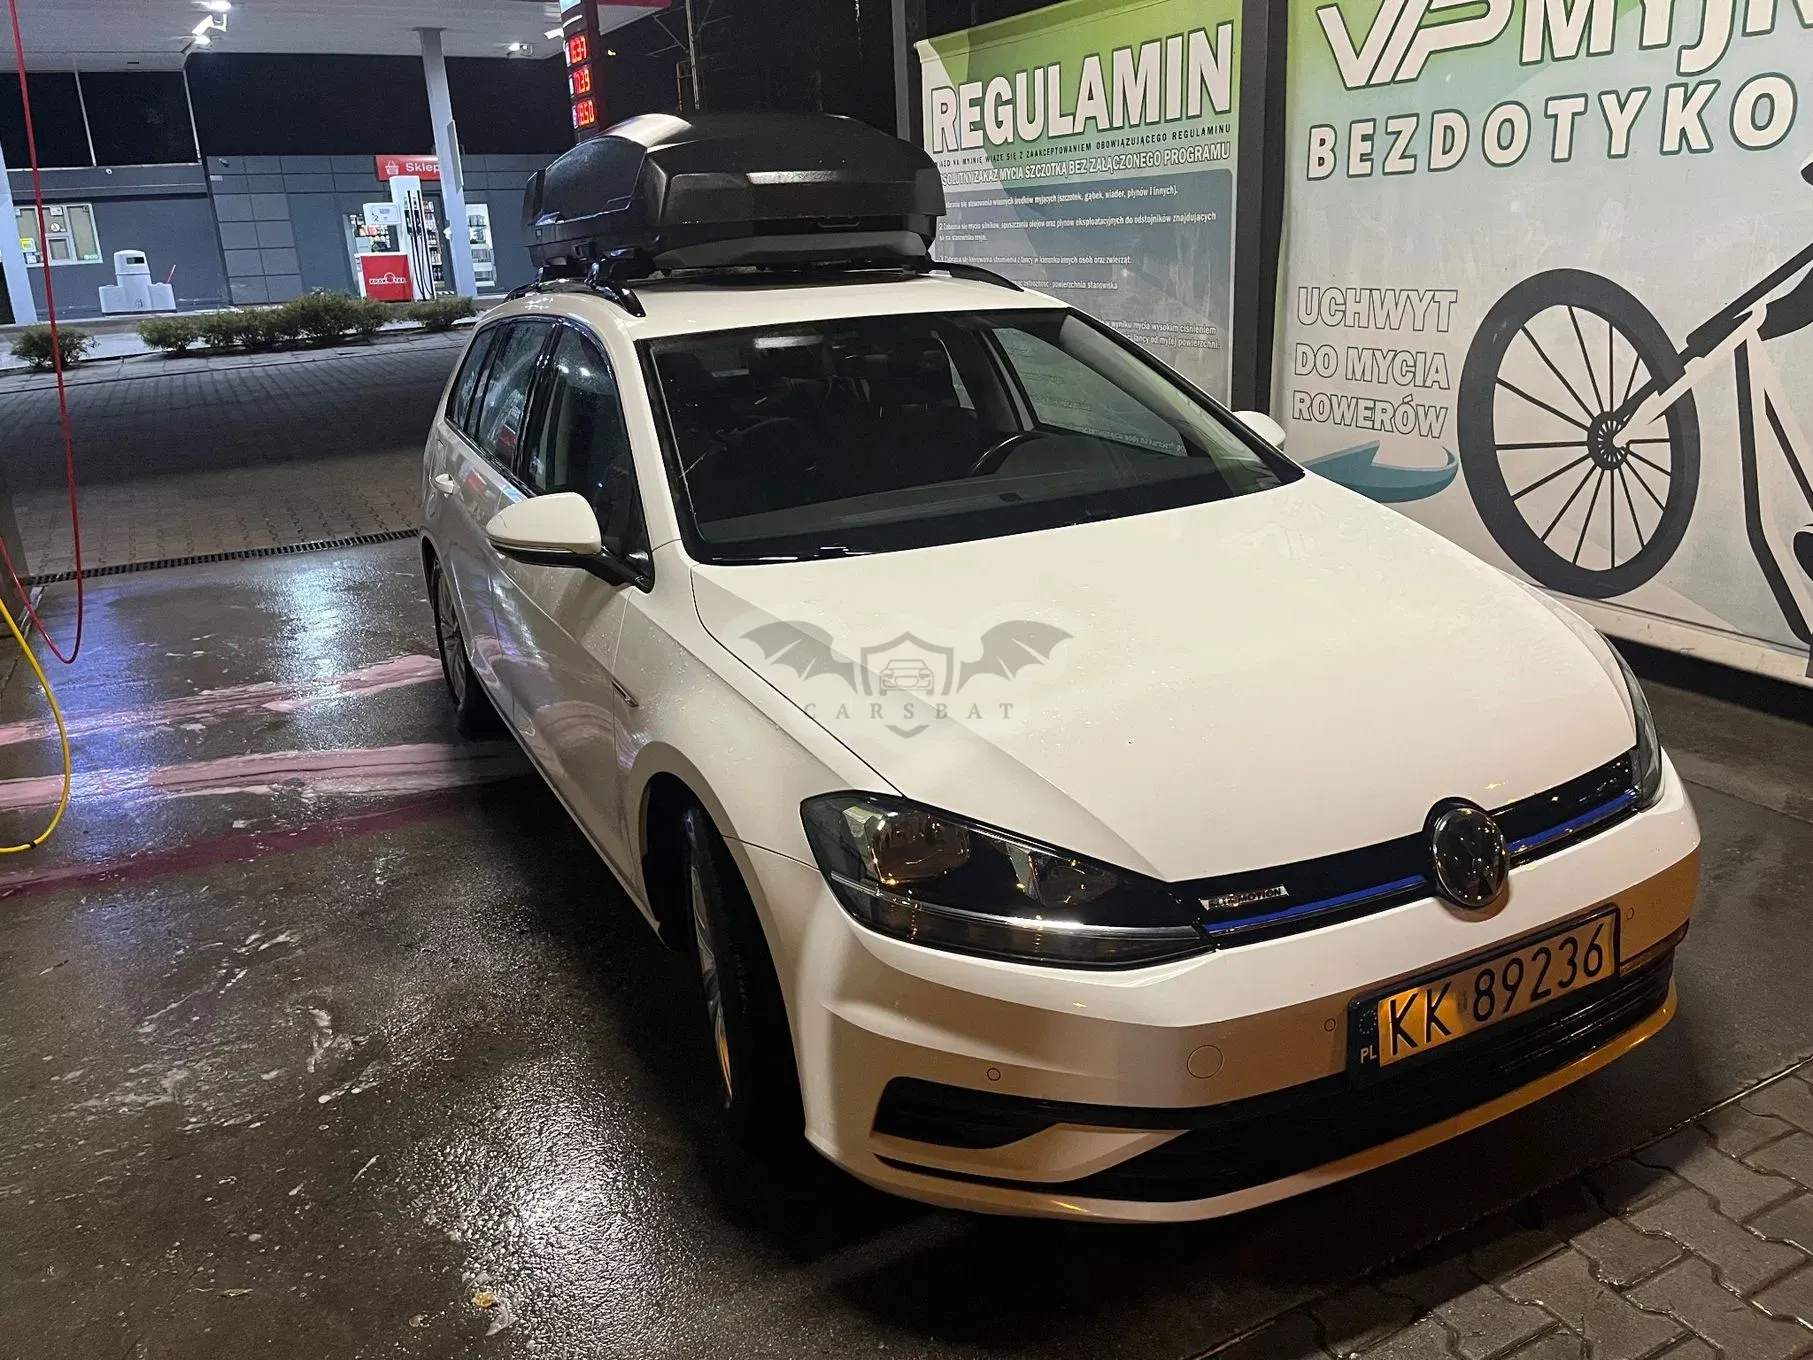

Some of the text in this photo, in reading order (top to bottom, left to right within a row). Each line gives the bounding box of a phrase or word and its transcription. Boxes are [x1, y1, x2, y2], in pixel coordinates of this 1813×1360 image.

[1315, 0, 1515, 90] VIP
[930, 19, 1234, 154] REGULAMIN
[1020, 151, 1024, 160] Z
[1026, 142, 1092, 159] ZAAKCEPTOWANIEM
[1096, 133, 1167, 150] OBOWIĄZUJĄCEGO
[1172, 123, 1232, 140] REGULAMINU
[1306, 72, 1798, 181] BEZDOTYKO
[406, 162, 441, 174] Sklep
[999, 165, 1024, 181] MYCIA
[1025, 160, 1068, 179] SZCZOTKĄ
[1069, 158, 1087, 175] BEZ
[1089, 149, 1162, 175] ZAŁĄCZONEGO
[1163, 141, 1232, 166] PROGRAMU
[1125, 215, 1134, 224] do
[1151, 321, 1179, 333] wysokim
[1180, 322, 1217, 335] ciśnieniem
[1297, 287, 1458, 332] UCHWYT
[1295, 342, 1450, 390] DO MYCIA
[1292, 390, 1448, 439] ROWERÓW
[1208, 886, 1282, 909] MOTION
[1360, 923, 1605, 1064] PL KK 89236
